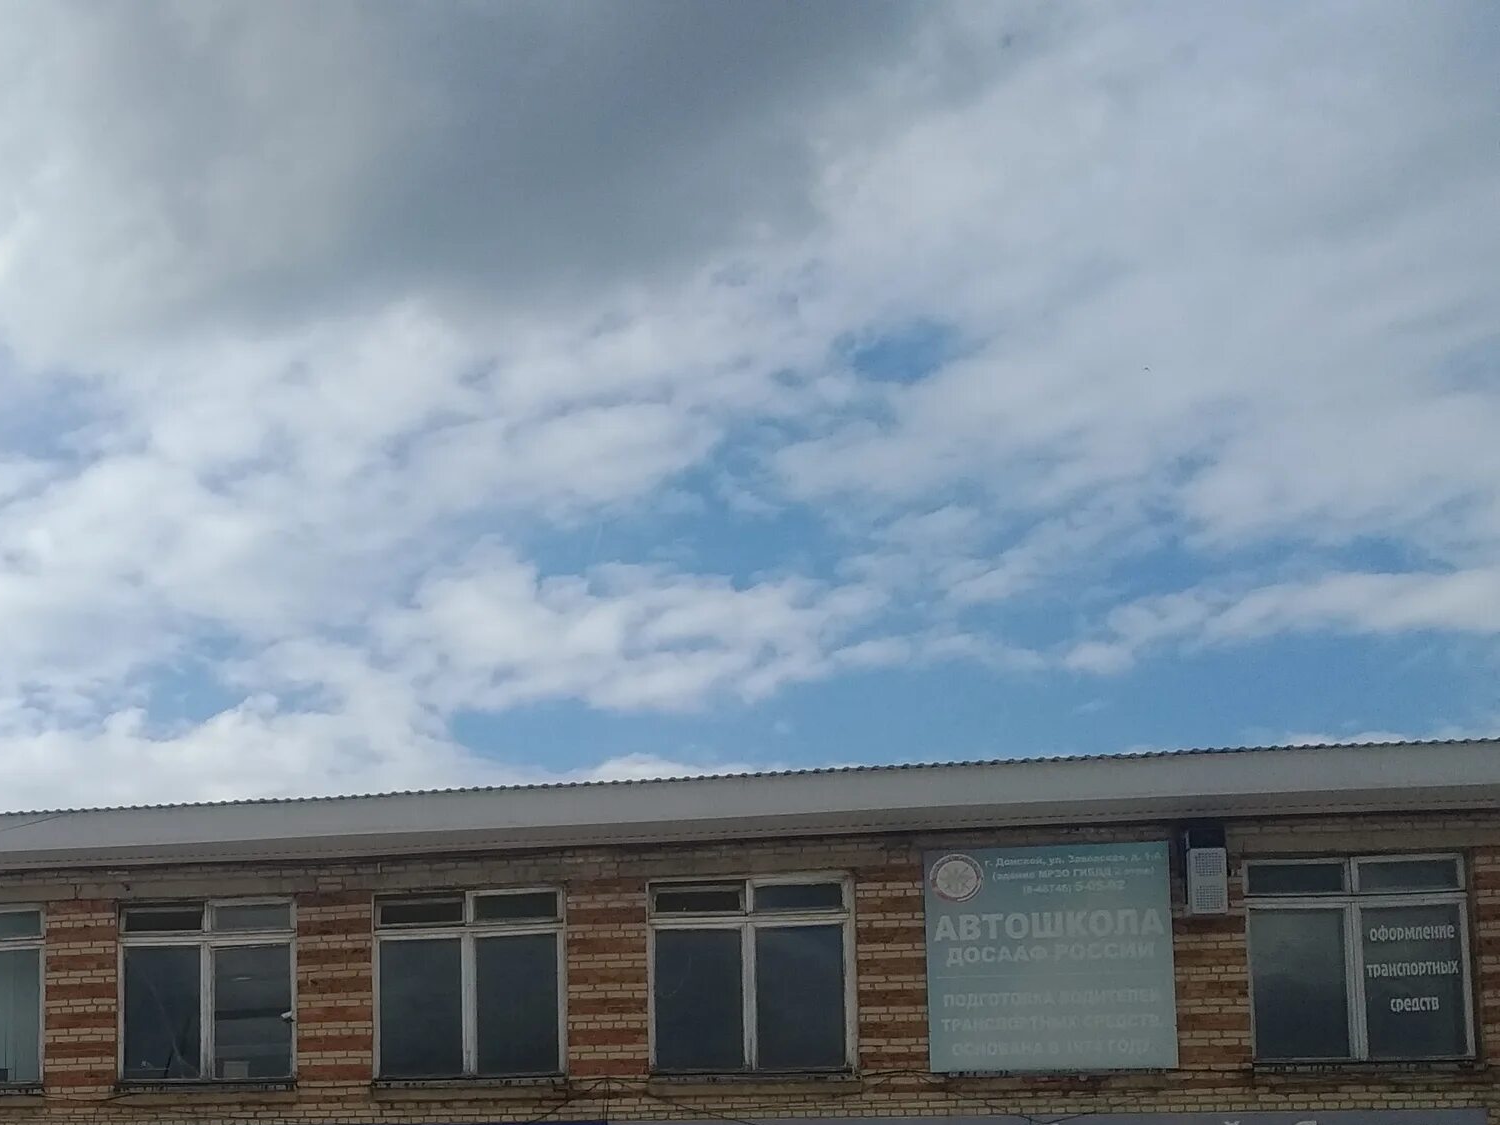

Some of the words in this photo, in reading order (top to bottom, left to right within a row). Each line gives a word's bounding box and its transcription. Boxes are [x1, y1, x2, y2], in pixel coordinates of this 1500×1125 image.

[1038, 868, 1070, 879] МРЭО
[934, 908, 1164, 941] АВТОШКОЛА
[1369, 924, 1455, 942] оформление
[946, 945, 1049, 967] ДОСААФ
[1053, 942, 1155, 962] РОССИИ
[1366, 960, 1459, 978] транспортных
[1390, 996, 1440, 1012] средств
